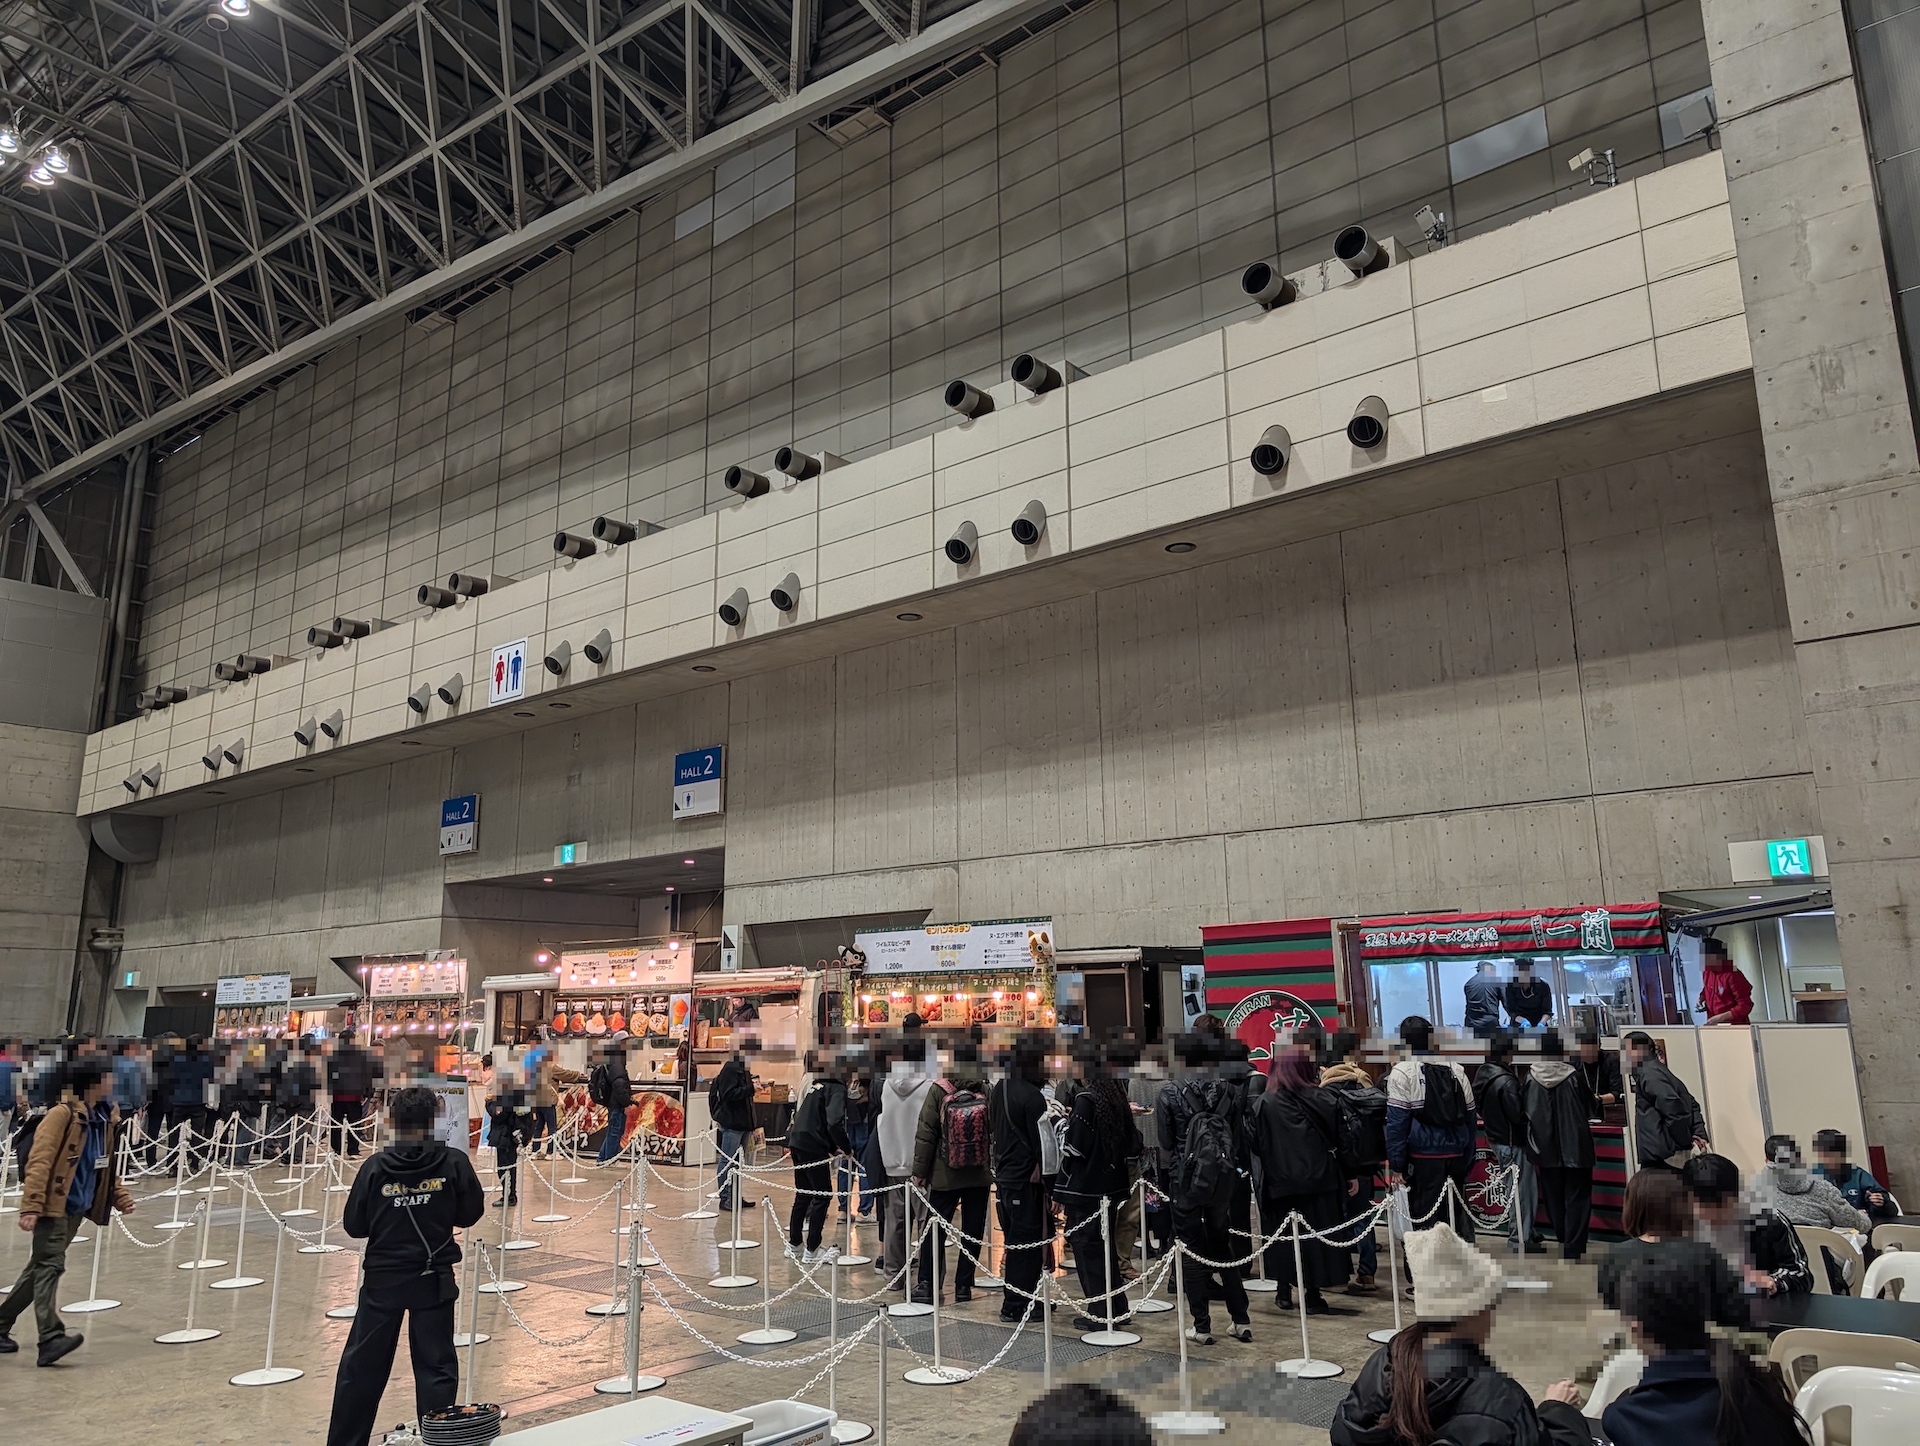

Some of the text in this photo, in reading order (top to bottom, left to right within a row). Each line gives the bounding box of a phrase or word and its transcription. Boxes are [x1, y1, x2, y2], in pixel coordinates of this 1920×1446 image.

[680, 754, 714, 780] HALL 2
[445, 801, 470, 822] HALL 2
[925, 924, 971, 935] モンハンキッチン
[1546, 907, 1615, 953] 一蘭
[884, 962, 904, 970] 1,200円
[941, 960, 956, 968] 600円
[1229, 994, 1272, 1028] CHIRAN
[394, 1194, 432, 1208] STAFF
